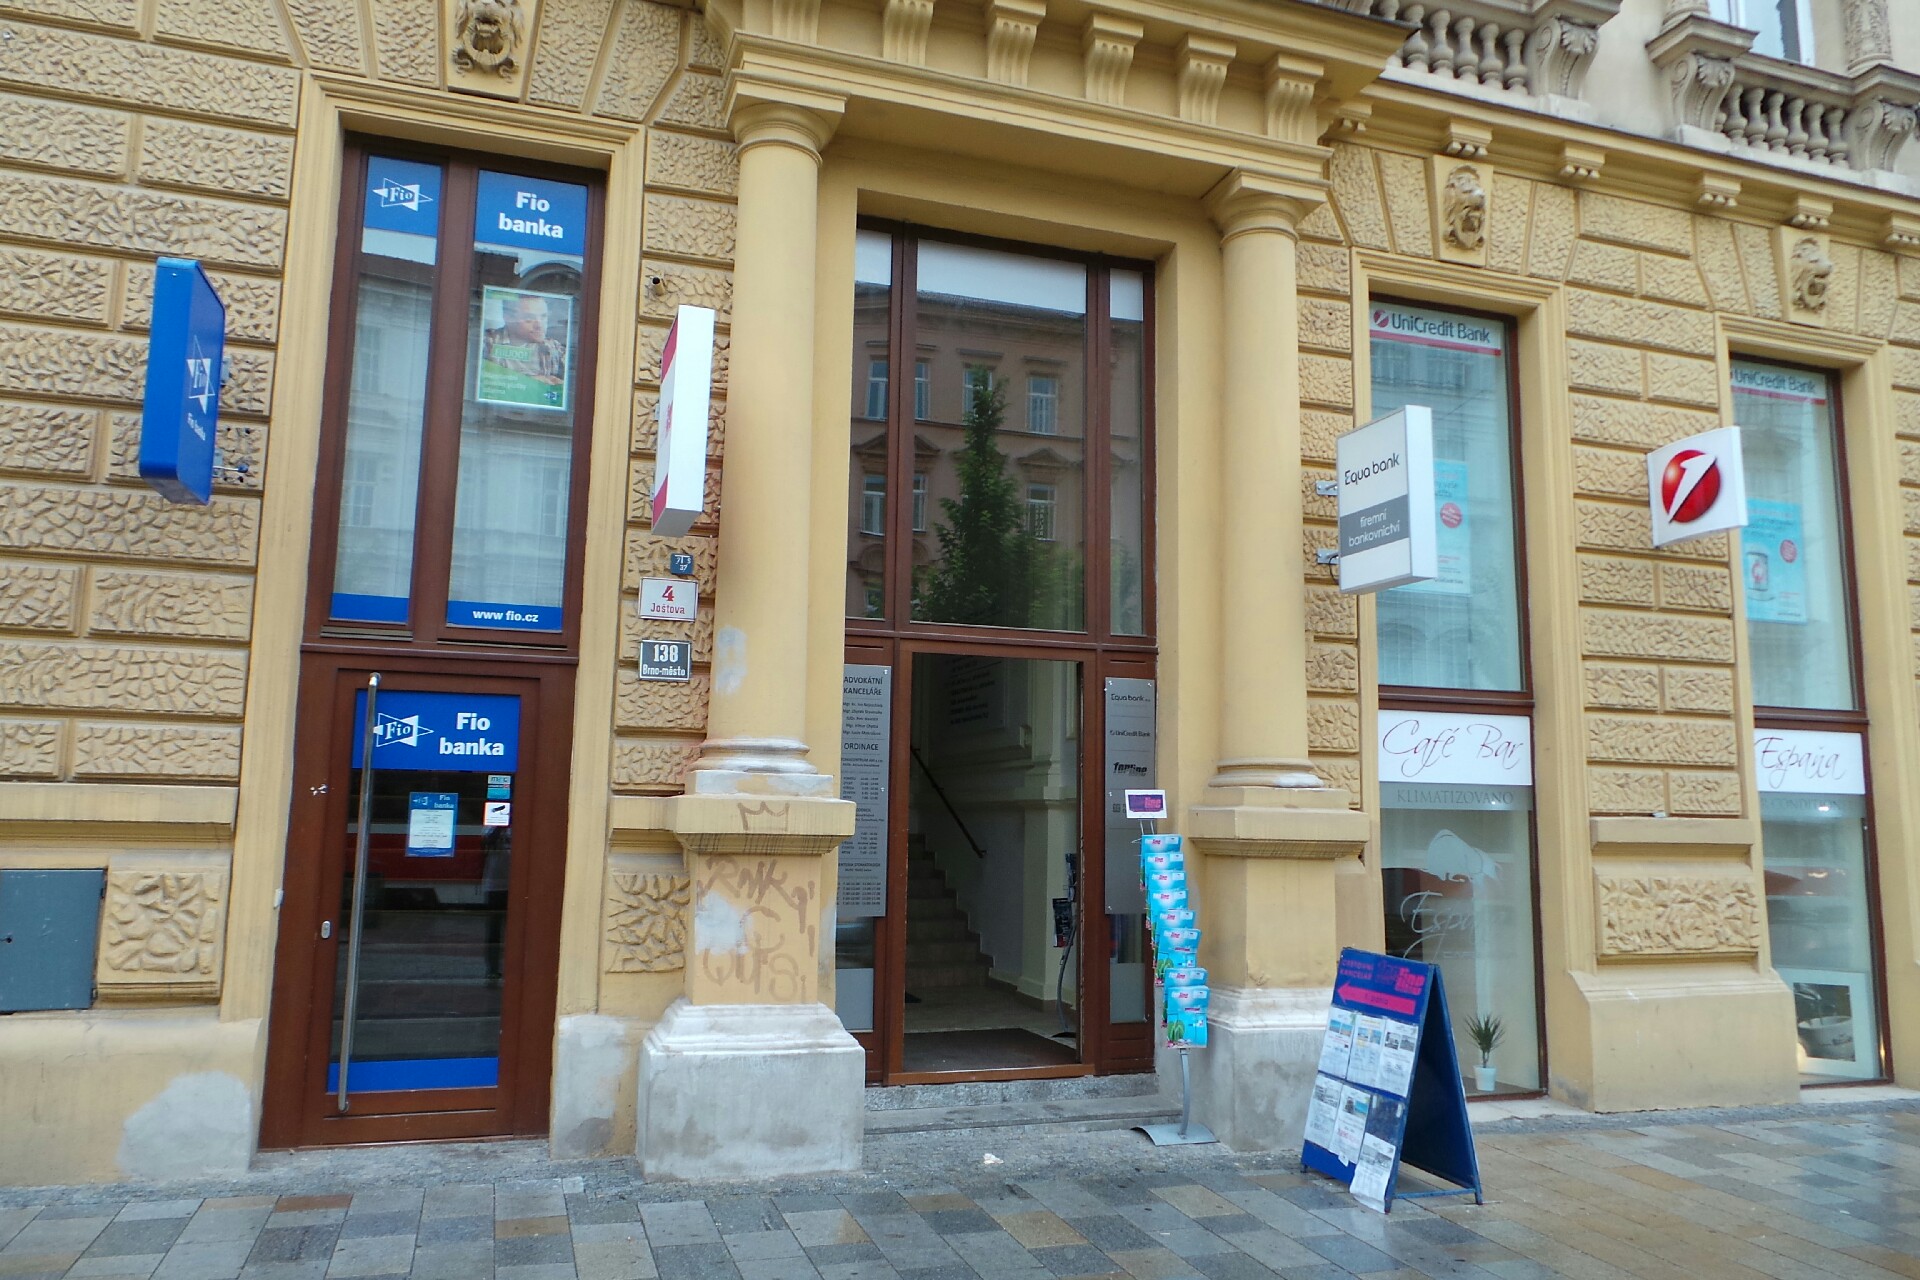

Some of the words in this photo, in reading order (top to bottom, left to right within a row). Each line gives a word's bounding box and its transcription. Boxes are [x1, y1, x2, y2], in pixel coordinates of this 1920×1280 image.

[389, 187, 413, 202] Fio
[516, 191, 550, 212] Fio
[498, 212, 564, 239] banka
[1392, 313, 1455, 338] UniCredit
[1457, 322, 1491, 344] Bank
[1735, 368, 1787, 390] UniCredit
[1788, 375, 1816, 393] Bank
[1344, 465, 1371, 486] Equa
[1372, 452, 1400, 475] bank
[1359, 507, 1387, 528] firemní
[1348, 519, 1401, 547] bankovnictví
[661, 585, 675, 602] 4
[650, 602, 686, 615] Joštova
[653, 644, 679, 663] 138
[642, 663, 686, 676] Brno-město
[843, 676, 883, 685] ADVOKÁTNÍ
[843, 687, 882, 696] KANCELÁŘE
[384, 721, 411, 740] Fio
[456, 712, 491, 731] Fio
[439, 737, 505, 756] banka
[843, 742, 879, 751] ORDINACE
[1382, 719, 1460, 778] Café
[1466, 723, 1524, 770] Bar
